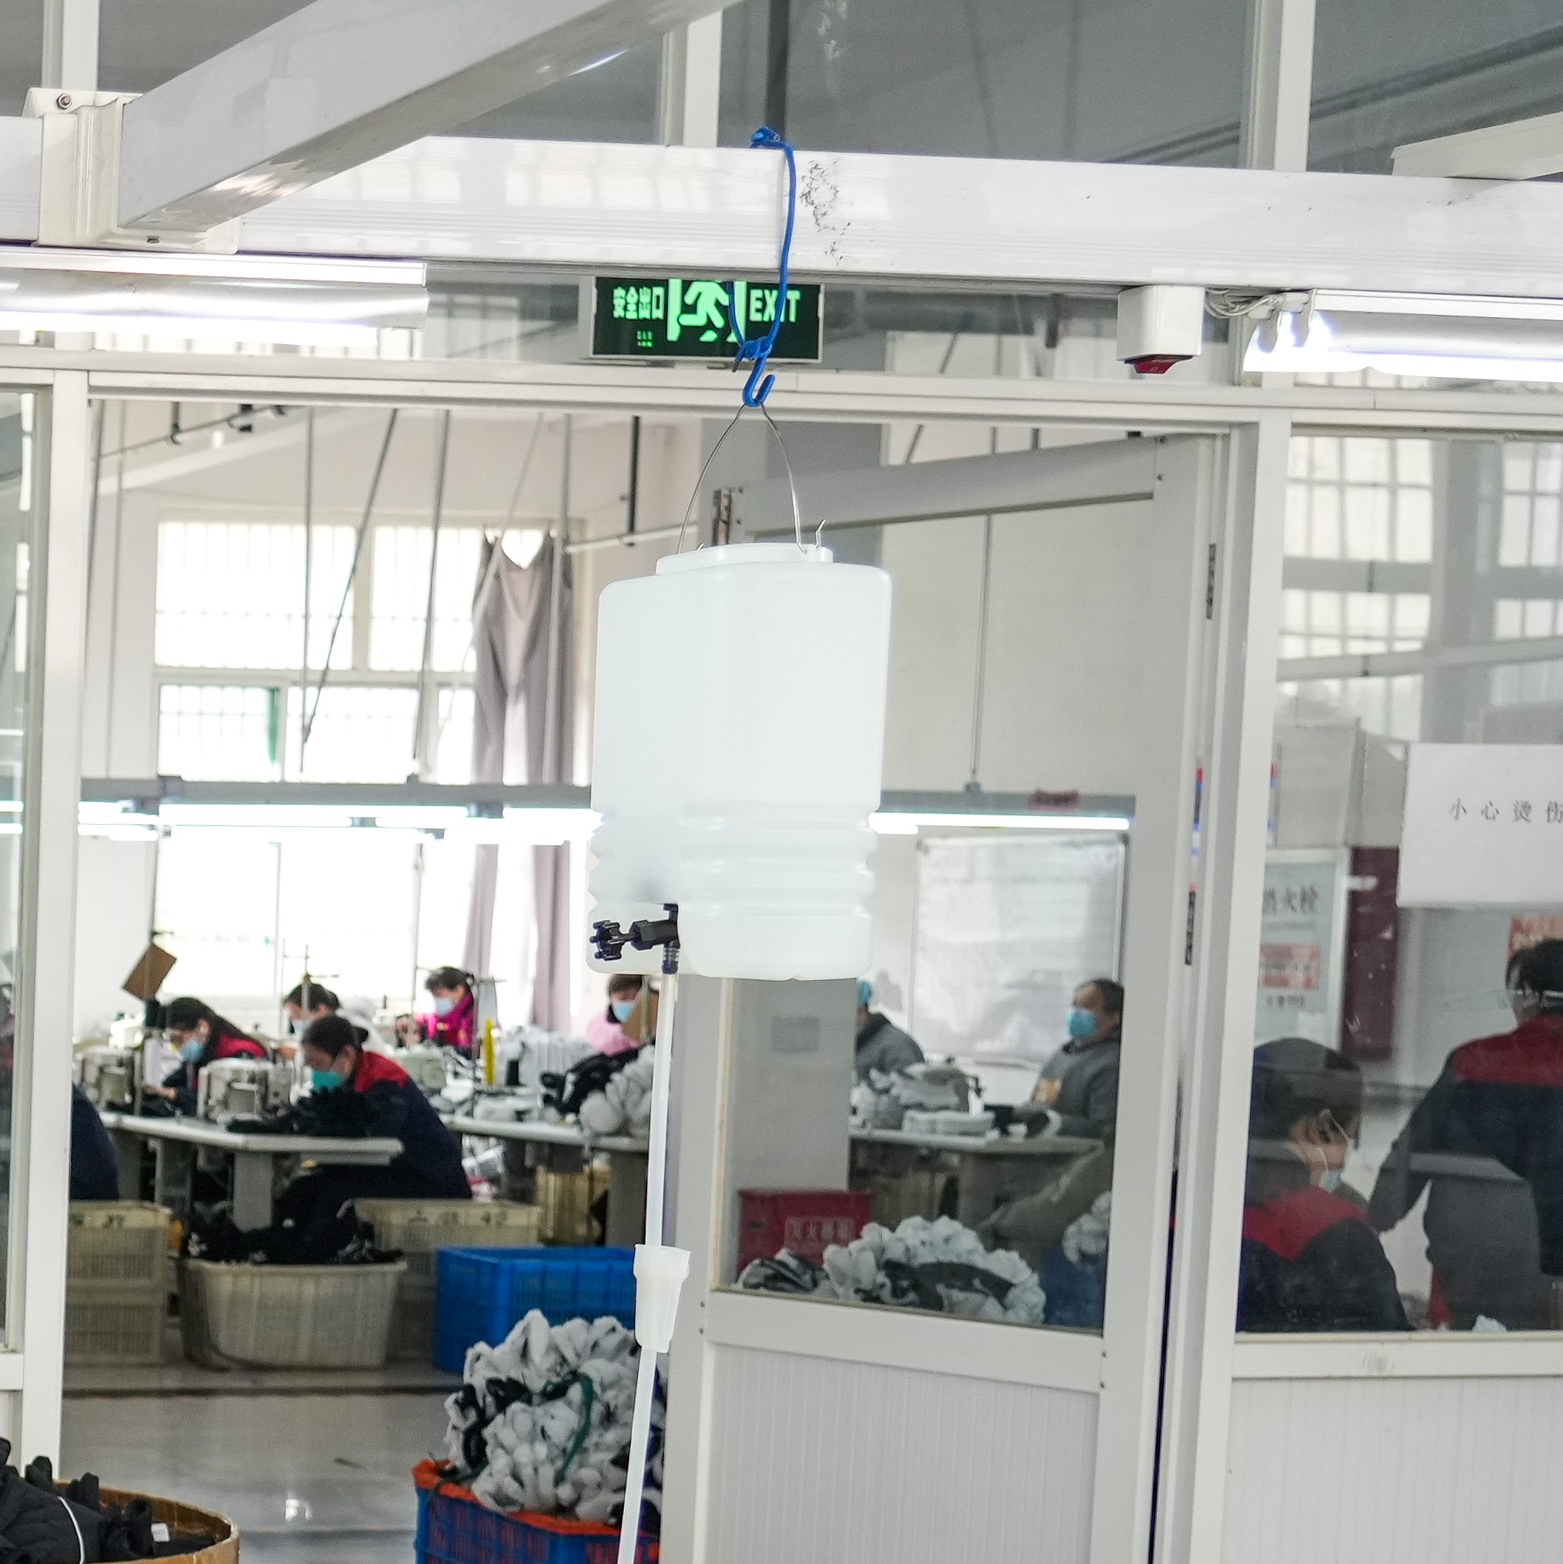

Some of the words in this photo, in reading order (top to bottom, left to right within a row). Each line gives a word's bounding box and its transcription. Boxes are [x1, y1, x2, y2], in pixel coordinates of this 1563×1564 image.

[613, 287, 664, 320] 安全出口
[750, 289, 801, 322] EXIT
[1450, 798, 1563, 822] 小心烫伤
